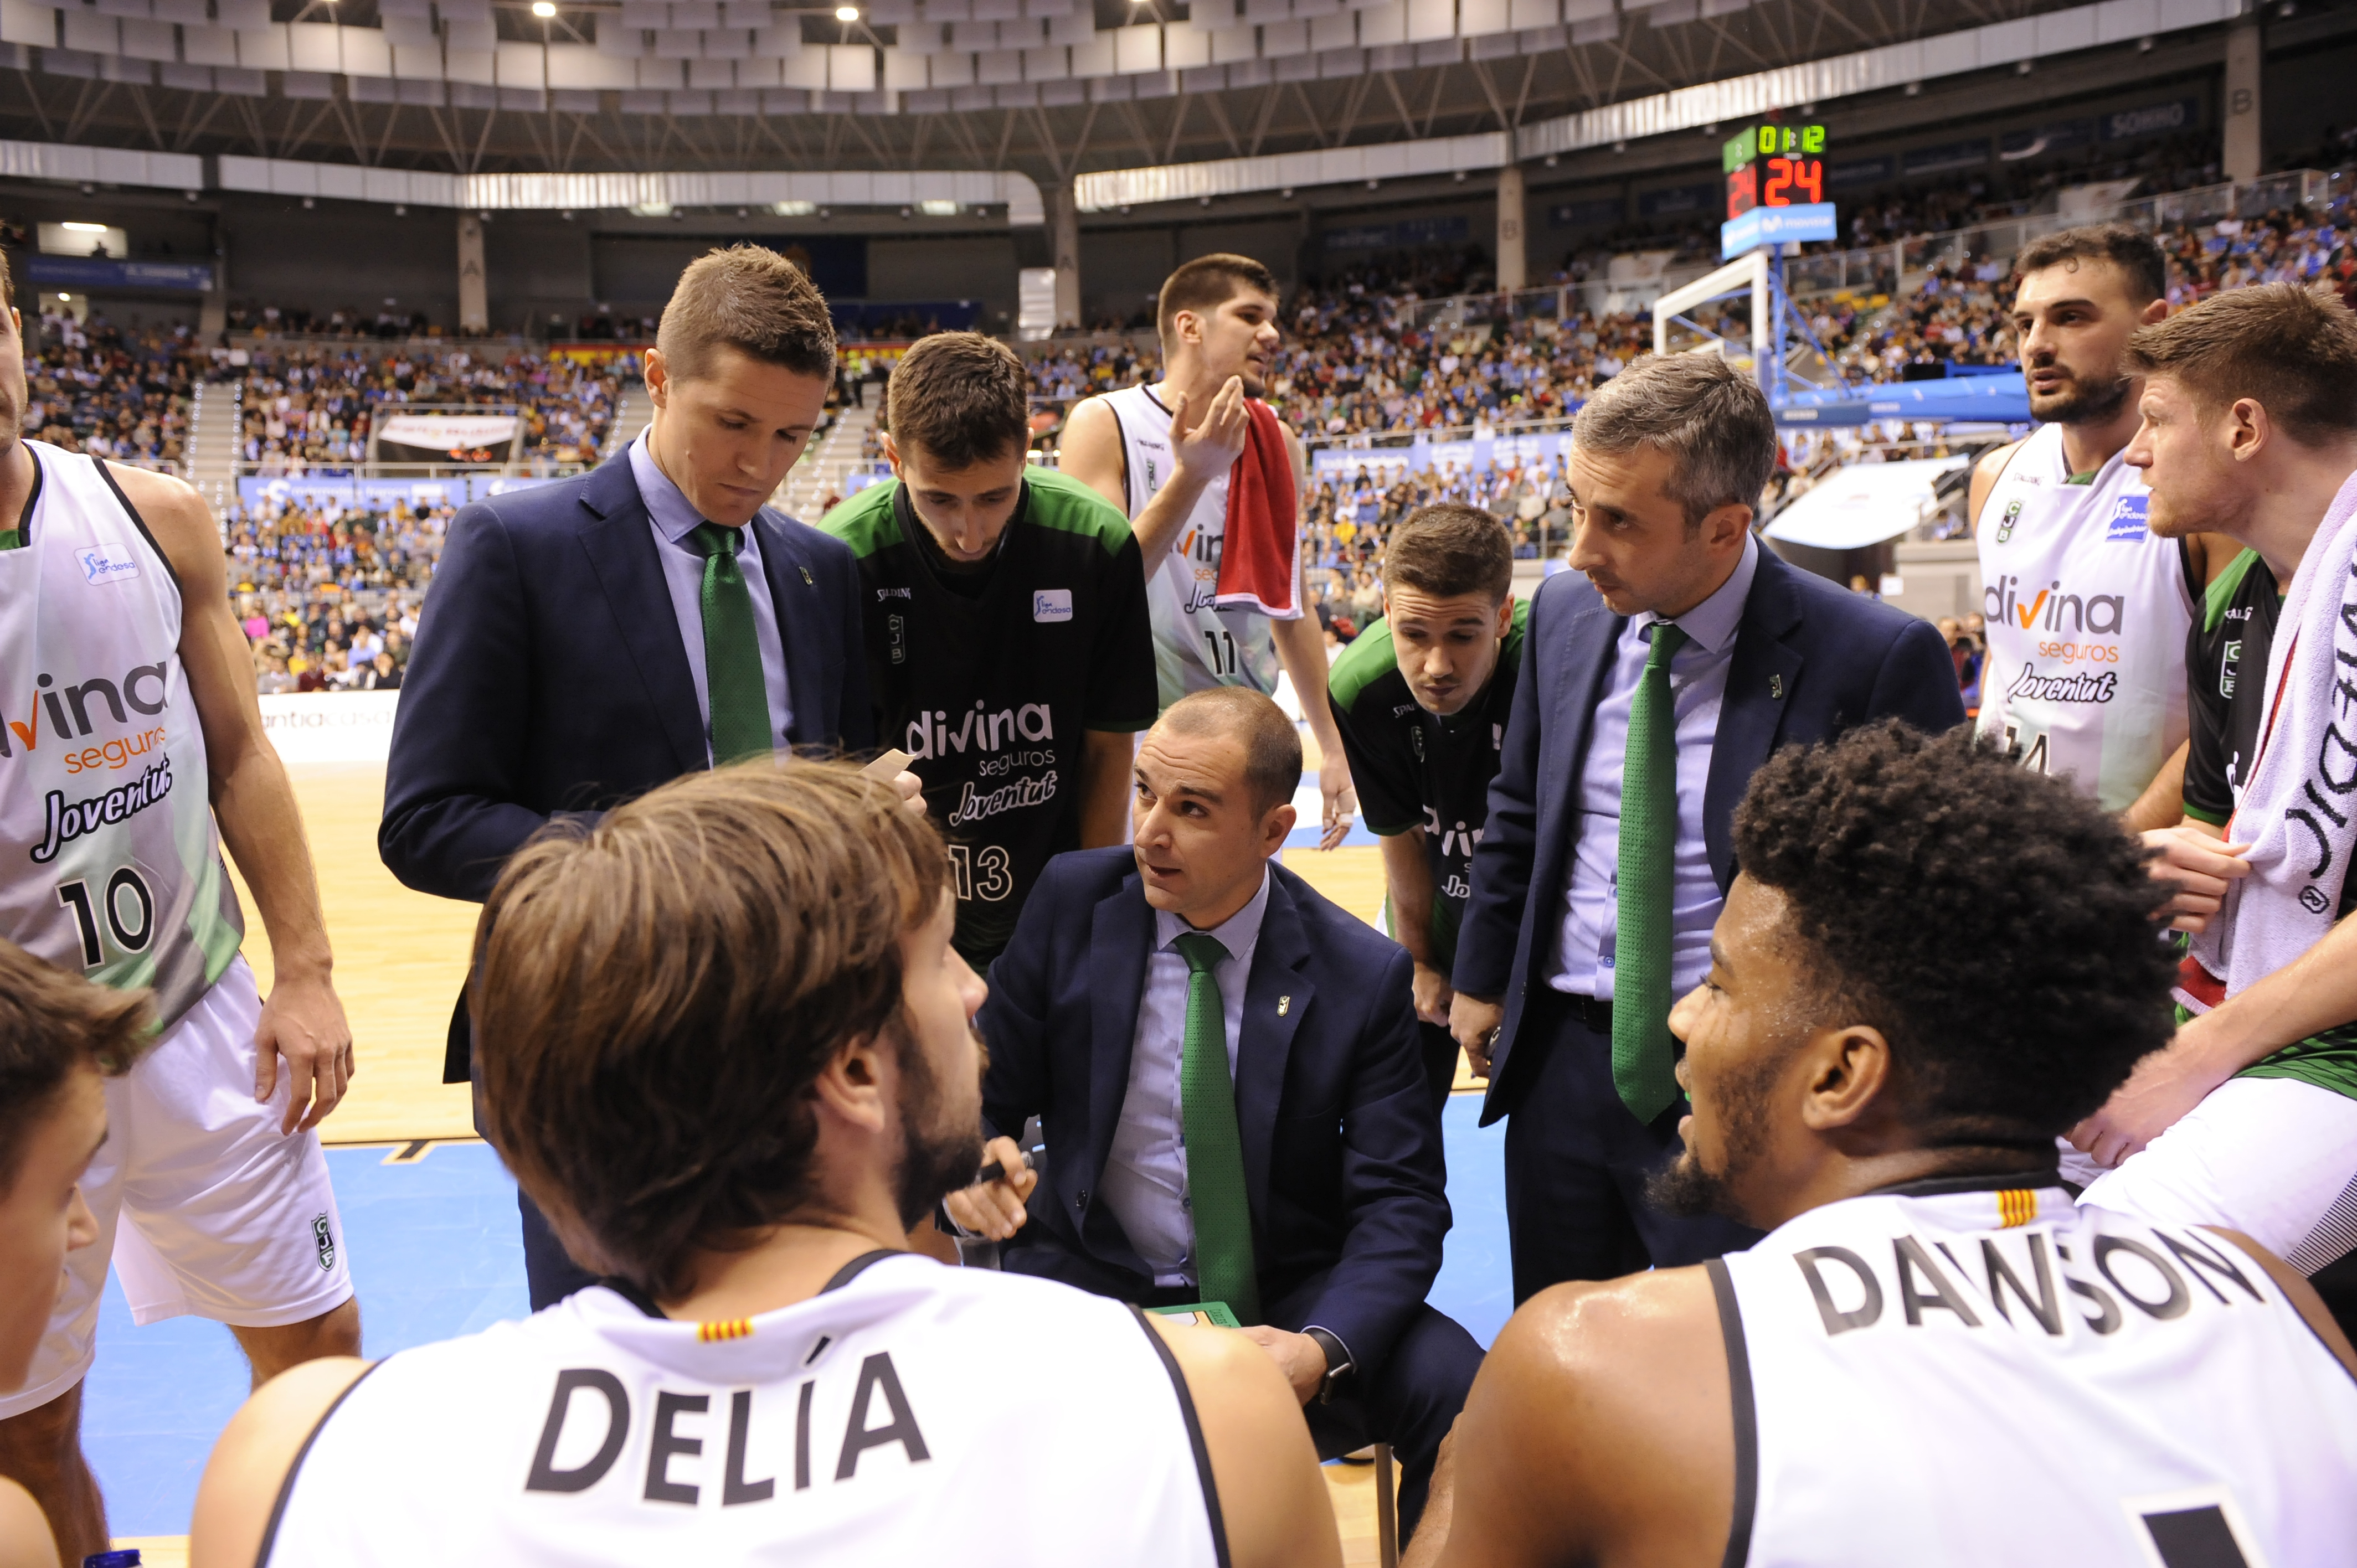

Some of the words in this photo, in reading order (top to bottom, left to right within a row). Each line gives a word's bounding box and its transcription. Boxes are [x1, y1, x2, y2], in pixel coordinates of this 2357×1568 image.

[1759, 126, 1824, 153] 01:12
[1765, 158, 1821, 208] 24
[92, 558, 109, 567] liga
[99, 562, 136, 574] endesa
[1985, 575, 2125, 635] divina
[1205, 630, 1236, 675] 11
[2039, 641, 2119, 665] seguros
[2007, 662, 2118, 704] Joventut
[0, 661, 168, 759] vina
[906, 699, 1053, 760] divina
[979, 749, 1056, 776] seguros
[949, 770, 1058, 827] Joventut
[948, 844, 1012, 901] 13
[55, 864, 156, 970] 10
[1792, 1226, 2267, 1338] DAWSON
[523, 1335, 933, 1508] DELÍA
